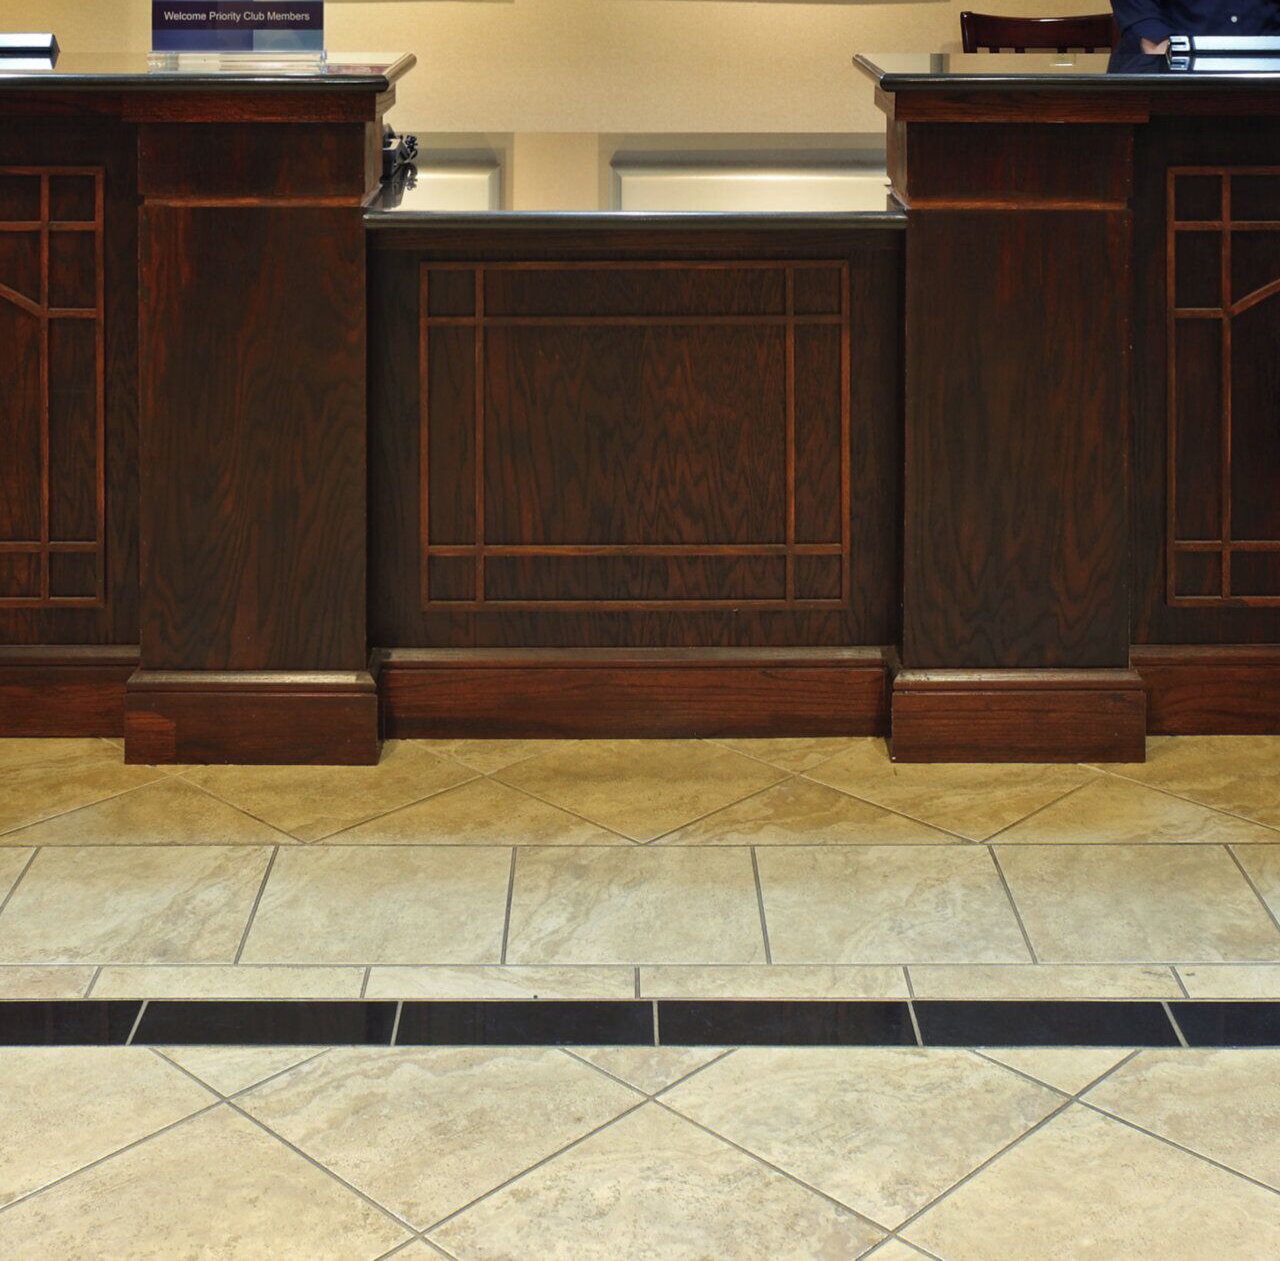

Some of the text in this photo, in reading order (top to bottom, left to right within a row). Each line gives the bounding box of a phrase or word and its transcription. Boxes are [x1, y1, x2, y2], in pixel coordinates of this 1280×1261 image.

[164, 12, 310, 22] Welcome Priority Club Members
